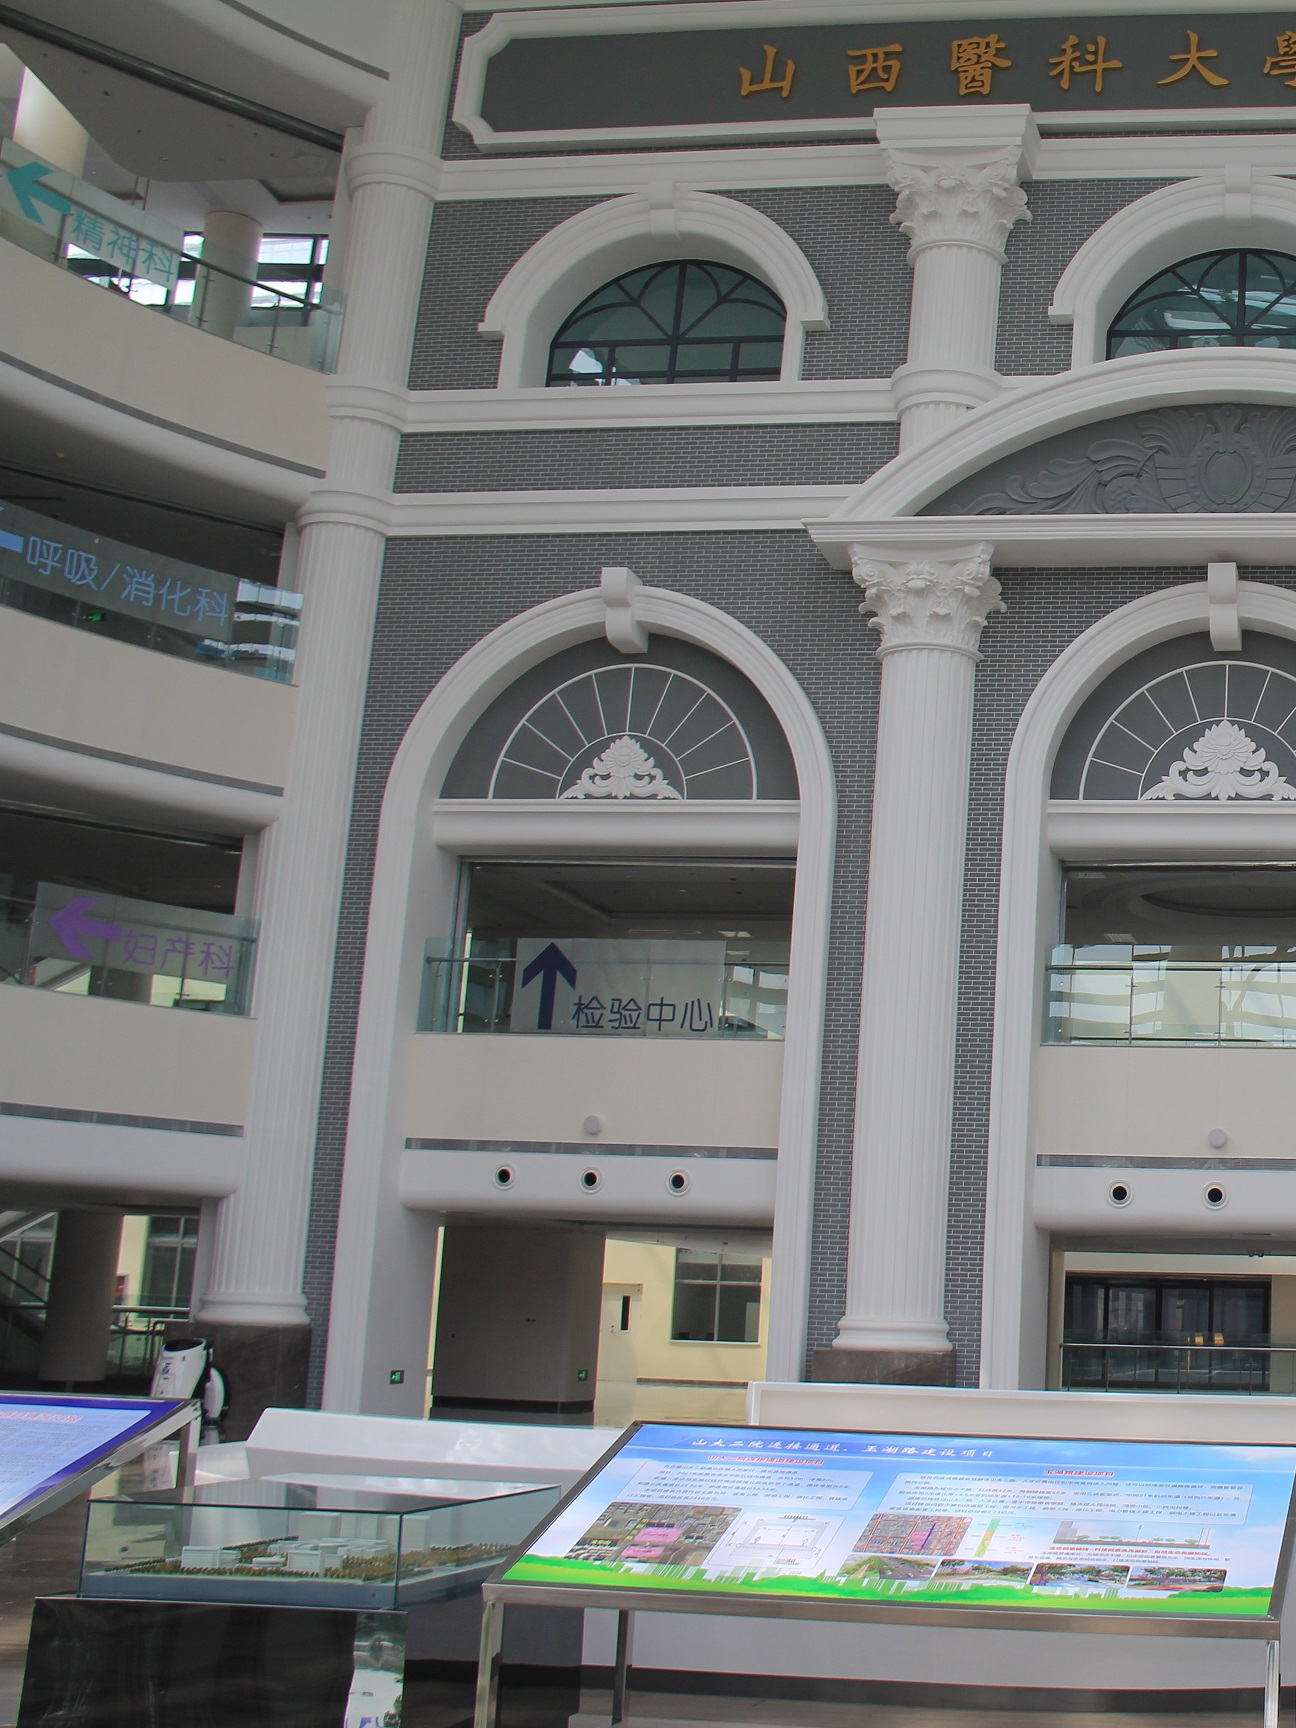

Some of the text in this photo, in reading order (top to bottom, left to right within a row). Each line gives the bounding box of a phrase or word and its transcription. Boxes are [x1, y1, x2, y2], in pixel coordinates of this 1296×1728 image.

[71, 208, 175, 283] 精神科
[27, 536, 229, 627] 呼吸/消化科
[123, 928, 233, 979] 妇产科
[572, 995, 714, 1032] 检验中心
